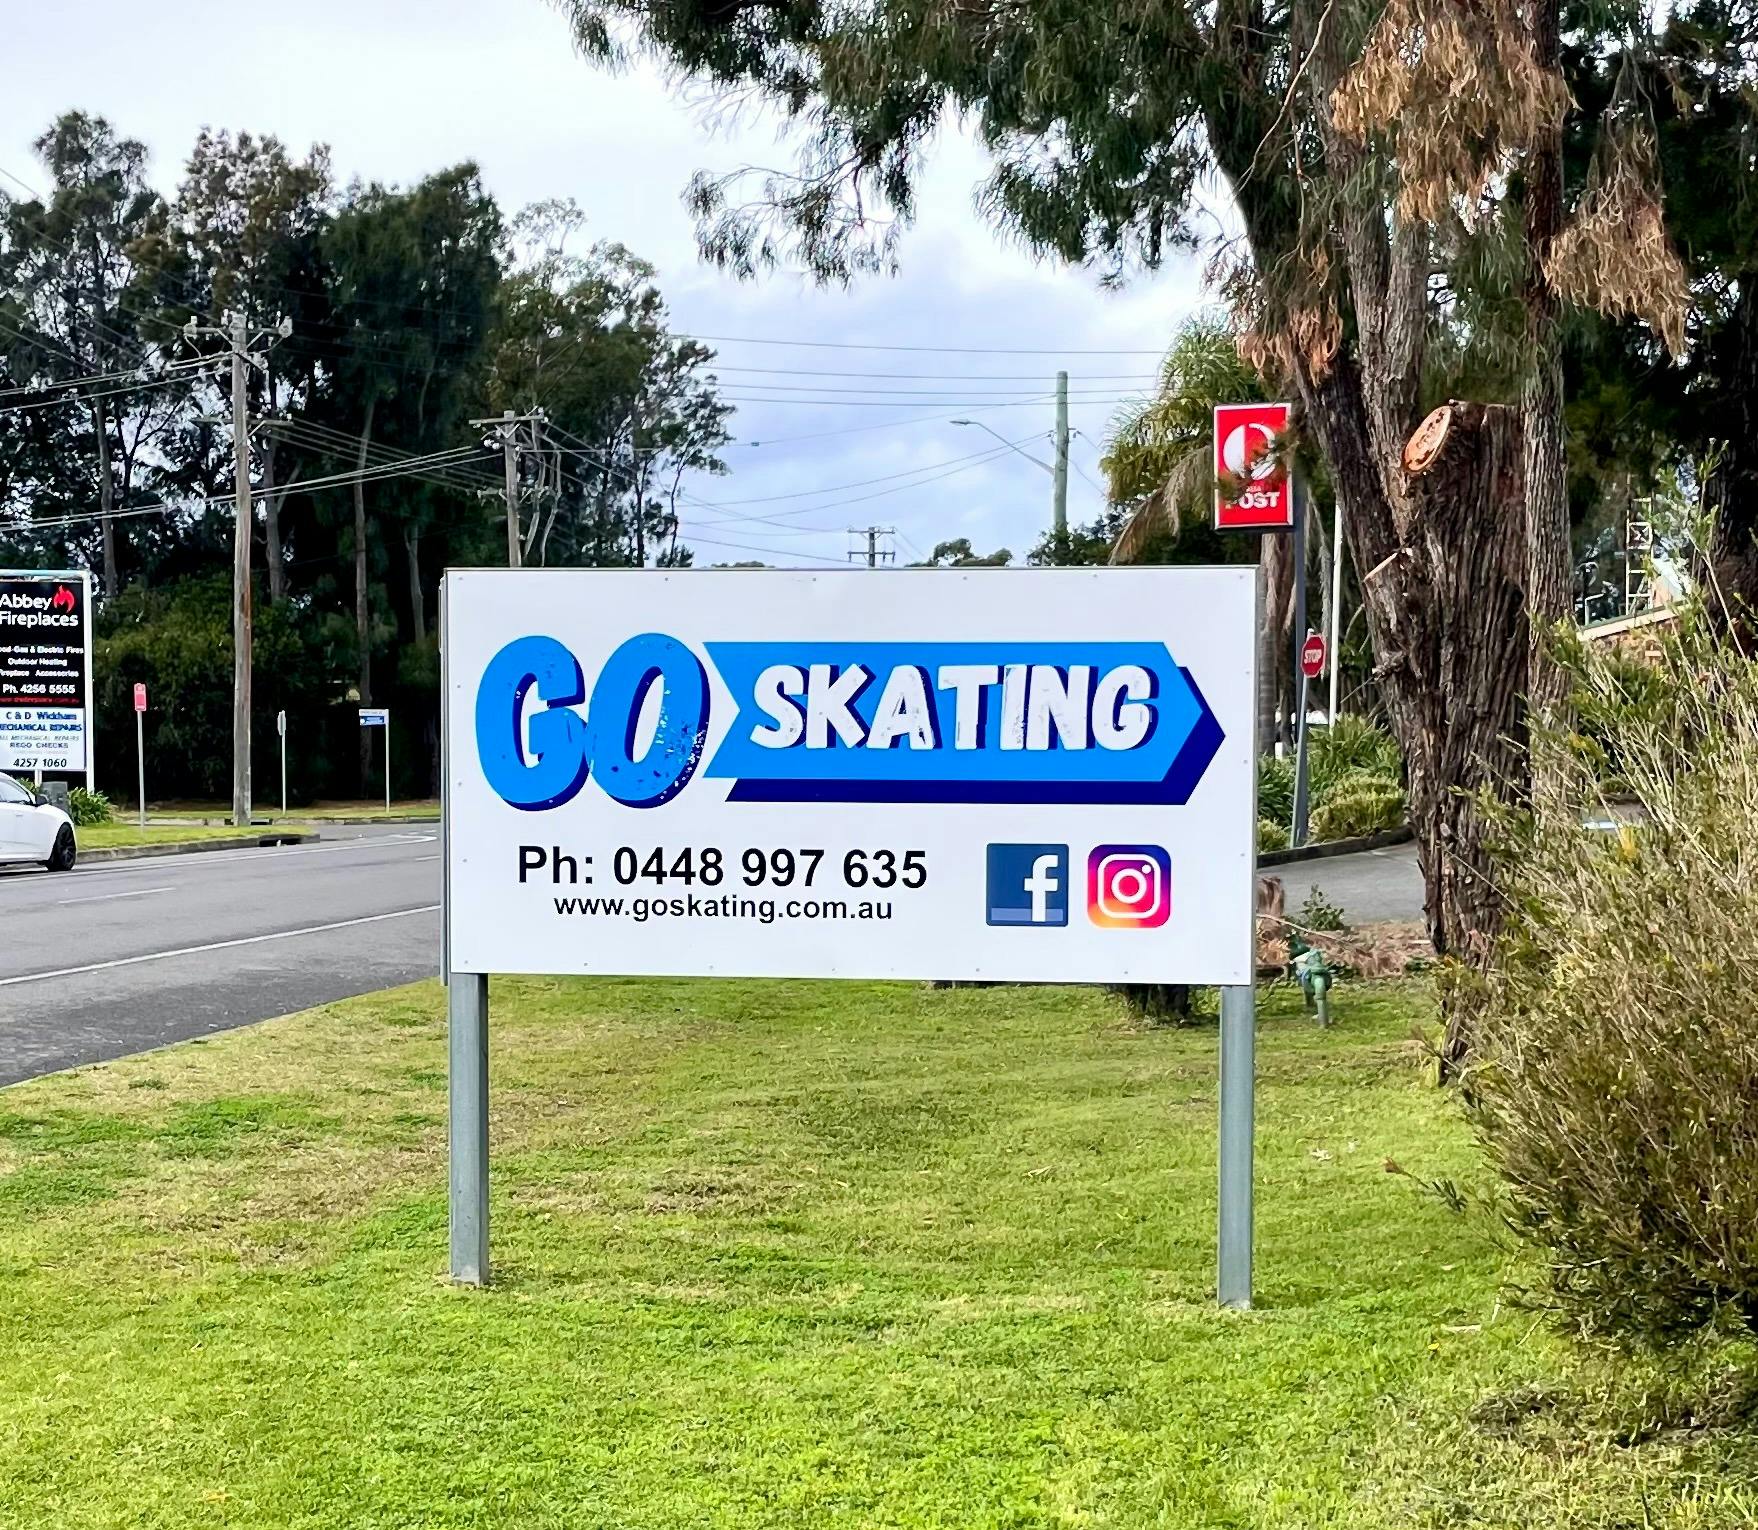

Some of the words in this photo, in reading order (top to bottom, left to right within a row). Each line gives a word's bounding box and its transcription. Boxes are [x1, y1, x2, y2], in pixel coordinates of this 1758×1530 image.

[0, 593, 52, 610] Abbey
[0, 611, 79, 628] Fireplaces
[8, 658, 38, 666] Outdoor
[39, 658, 68, 667] Heating
[1304, 649, 1322, 664] STOP
[49, 685, 76, 695] 5555
[6, 711, 12, 720] C
[24, 711, 32, 720] D
[36, 711, 78, 720] Wickham
[749, 664, 1160, 751] SKATING
[474, 632, 711, 811] GO
[13, 758, 38, 768] 4257
[42, 758, 67, 768] 1060
[518, 845, 594, 885] Ph:
[613, 846, 724, 887] 0448
[741, 847, 825, 887] 997
[843, 849, 927, 889] 635
[554, 893, 893, 924] www.goskating.com.au
